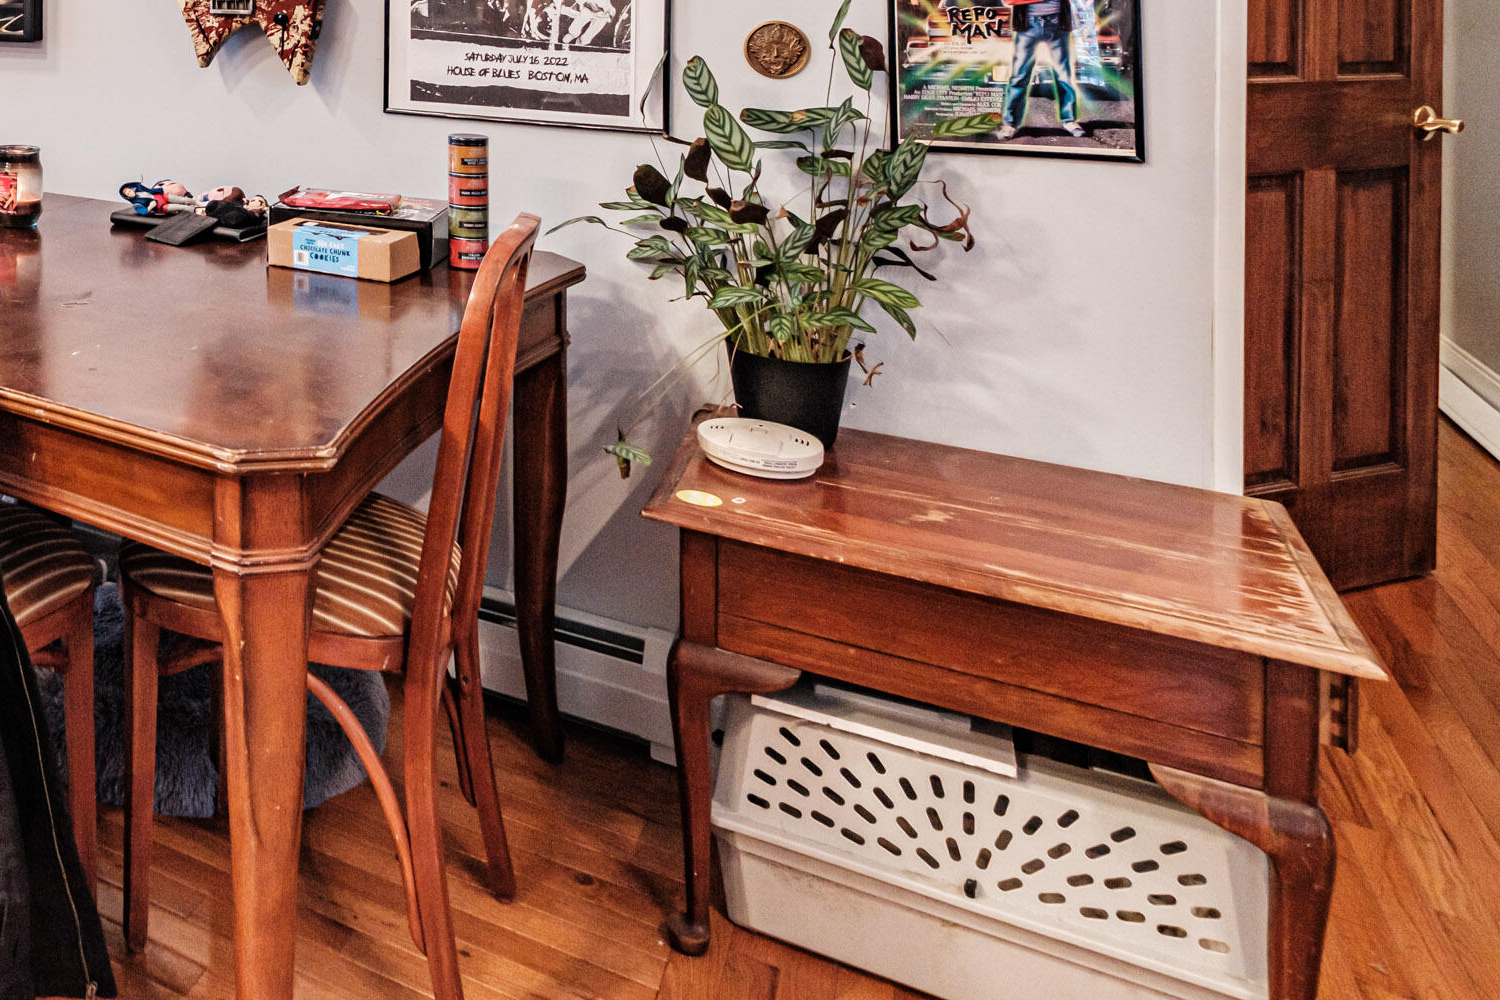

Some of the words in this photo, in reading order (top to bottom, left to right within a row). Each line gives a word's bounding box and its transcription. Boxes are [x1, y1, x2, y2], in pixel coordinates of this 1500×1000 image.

[946, 6, 997, 25] REPO
[951, 18, 1003, 45] MAN
[464, 52, 506, 63] SATURDAY
[508, 55, 528, 64] JULY
[529, 56, 540, 65] 16
[544, 56, 569, 66] 2022
[447, 66, 475, 77] HOUSE
[478, 67, 489, 77] OF
[492, 68, 521, 79] BLUES
[574, 73, 589, 84] MA
[300, 244, 328, 254] CHOCOLATE
[330, 248, 351, 257] CHUNK
[310, 252, 339, 263] COOKIES
